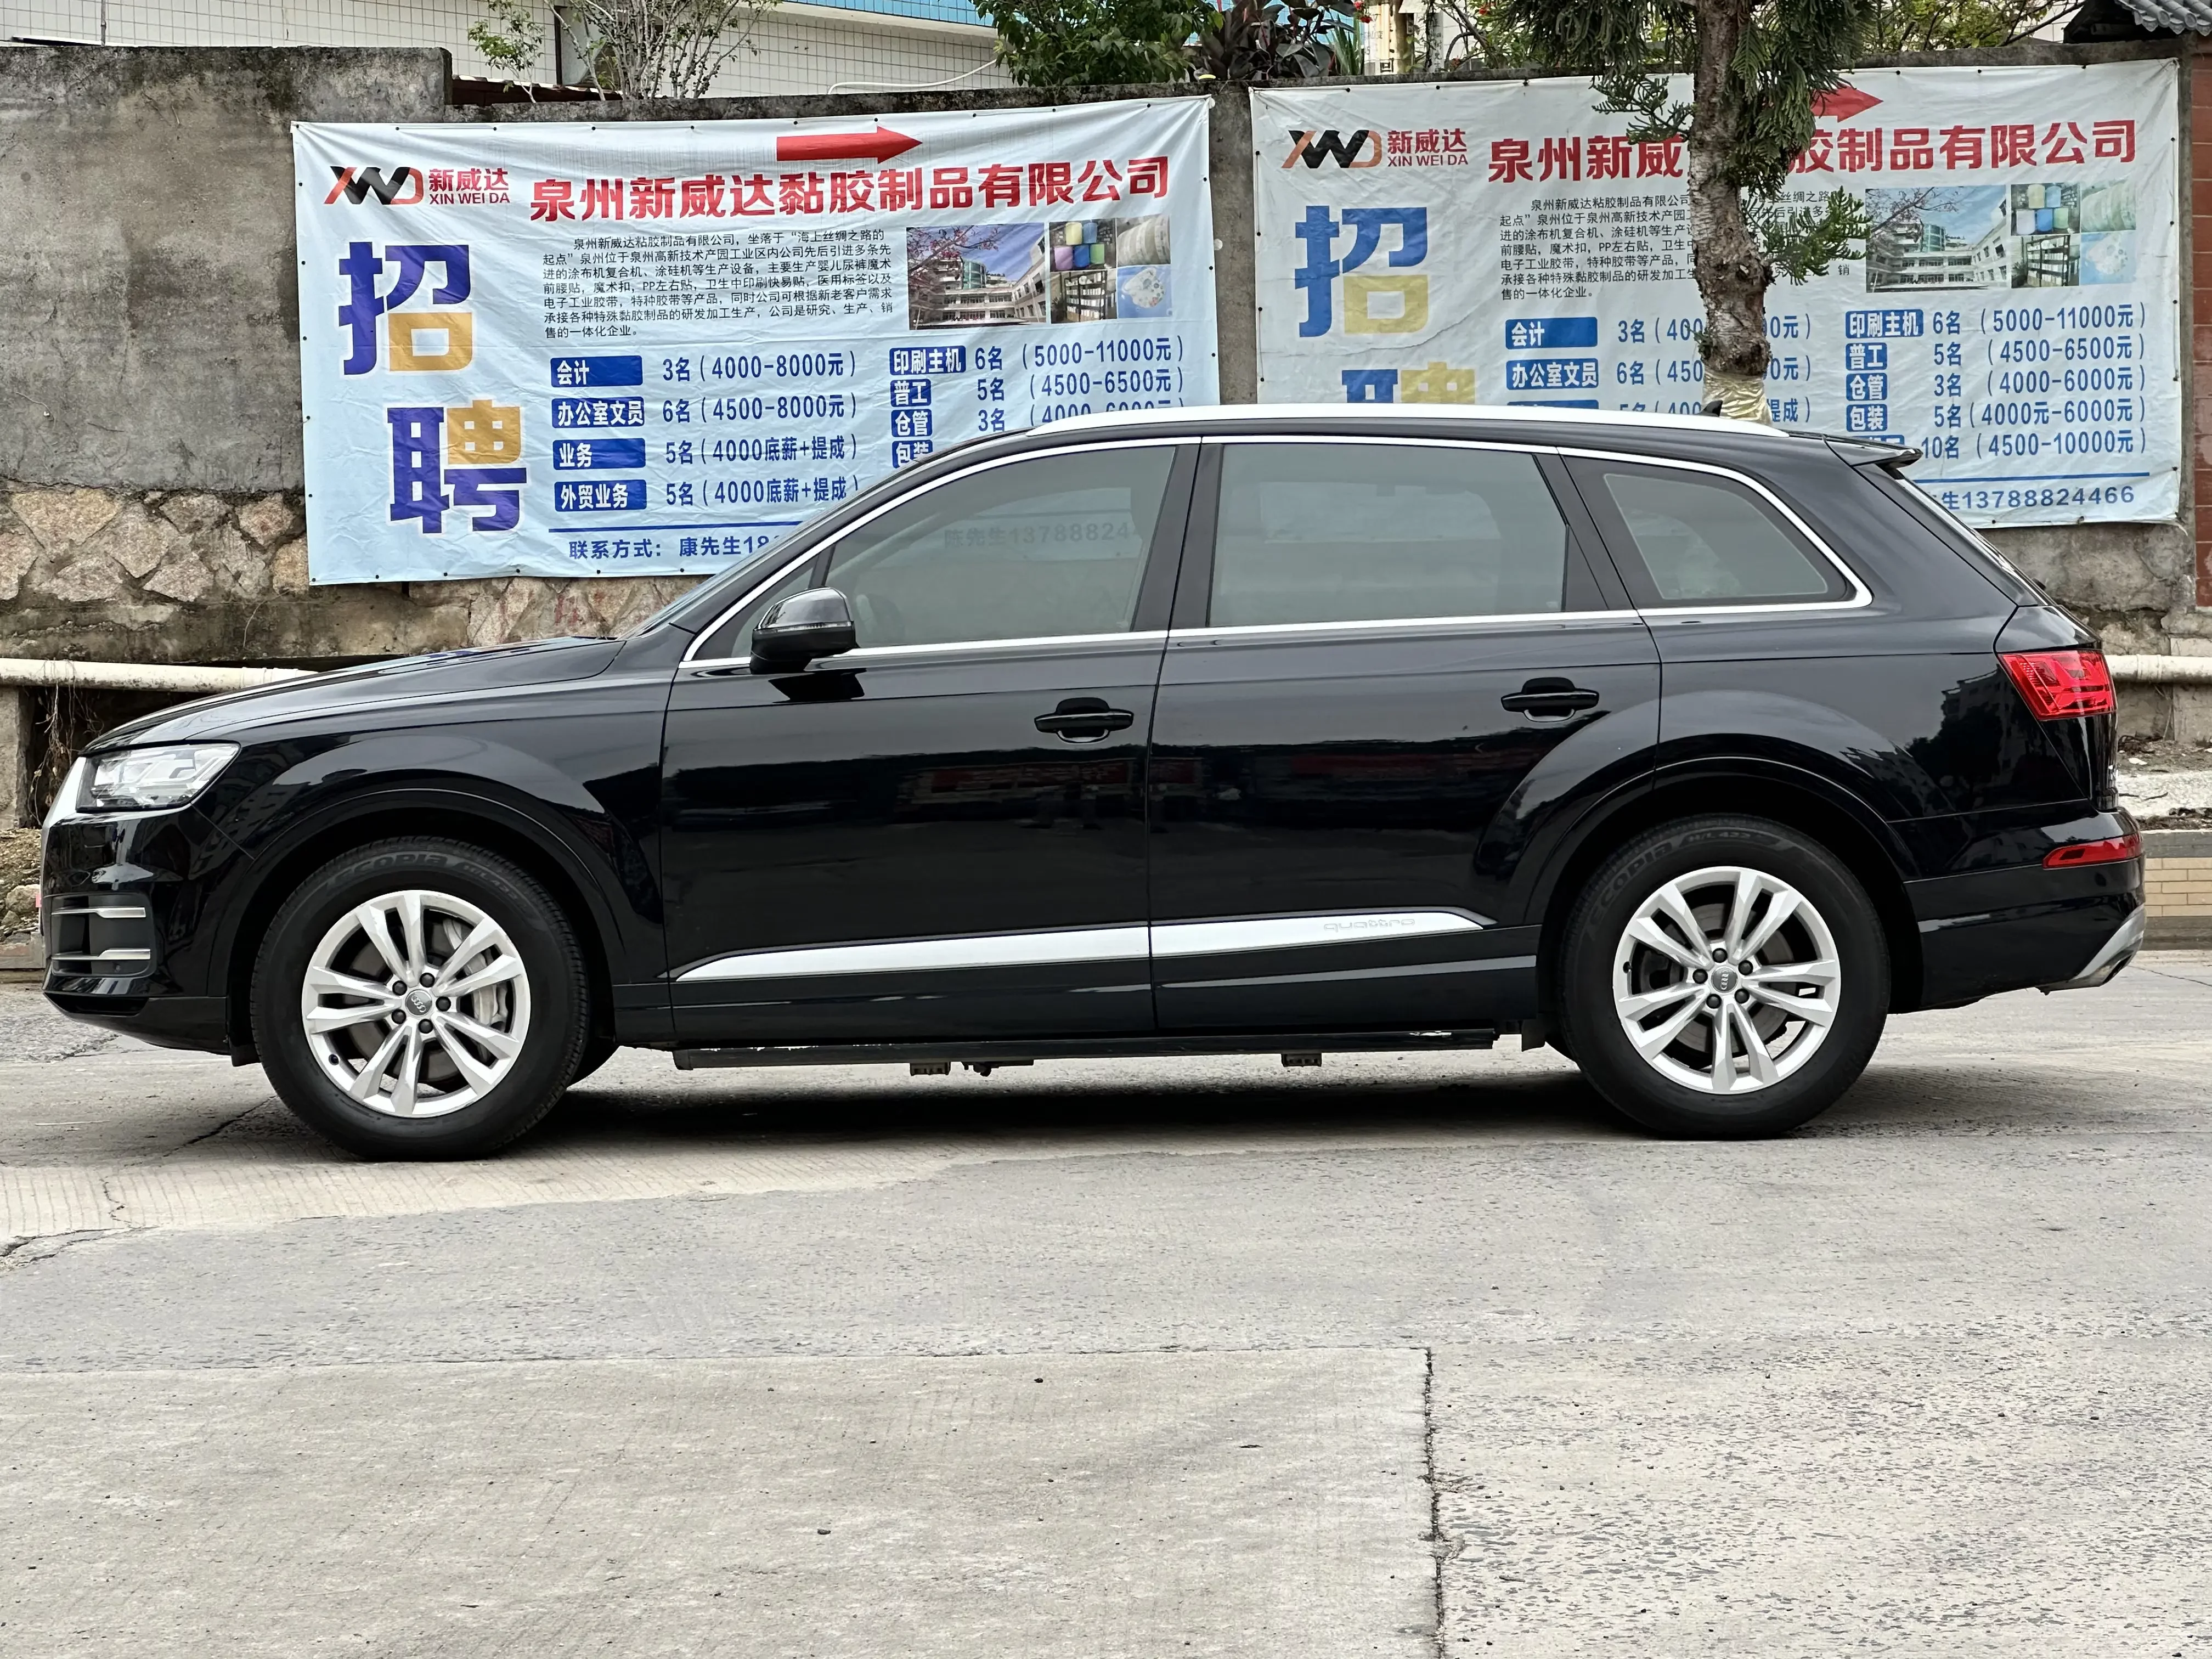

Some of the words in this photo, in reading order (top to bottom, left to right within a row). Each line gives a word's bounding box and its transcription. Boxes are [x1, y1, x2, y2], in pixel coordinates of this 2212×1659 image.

[1387, 128, 1468, 154] 新威达
[1388, 154, 1415, 167] XIN
[1417, 154, 1443, 167] WEI
[1446, 153, 1468, 166] DA
[428, 168, 509, 191] 新威达
[530, 156, 1169, 222] 泉州新威达黏胶制品有限公司
[430, 193, 456, 205] XIN
[459, 192, 486, 205] WEI
[489, 191, 510, 205] DA
[1502, 286, 1593, 300] 售的一体化企业。
[545, 325, 637, 338] 售的一体化企业。
[1511, 321, 1545, 347] 会计
[1849, 311, 1919, 337] 印刷主机
[1933, 311, 1960, 335] 6名
[894, 348, 962, 373] 印刷主机
[975, 347, 1003, 371] 6名
[1849, 344, 1883, 369] 普工
[1934, 342, 1961, 366] 5名
[556, 360, 590, 385] 会计
[1512, 362, 1598, 388] 办公室文员
[894, 382, 928, 404] 普工
[978, 377, 1005, 402] 5名
[1850, 375, 1883, 400] 仓管
[1934, 373, 1961, 397] 3名
[557, 400, 643, 426] 办公室文员
[895, 410, 929, 436] 仓管
[1850, 406, 1884, 431] 包装
[560, 442, 592, 468] 业务
[560, 483, 629, 510] 外贸业务
[1324, 918, 1415, 933] quattro
